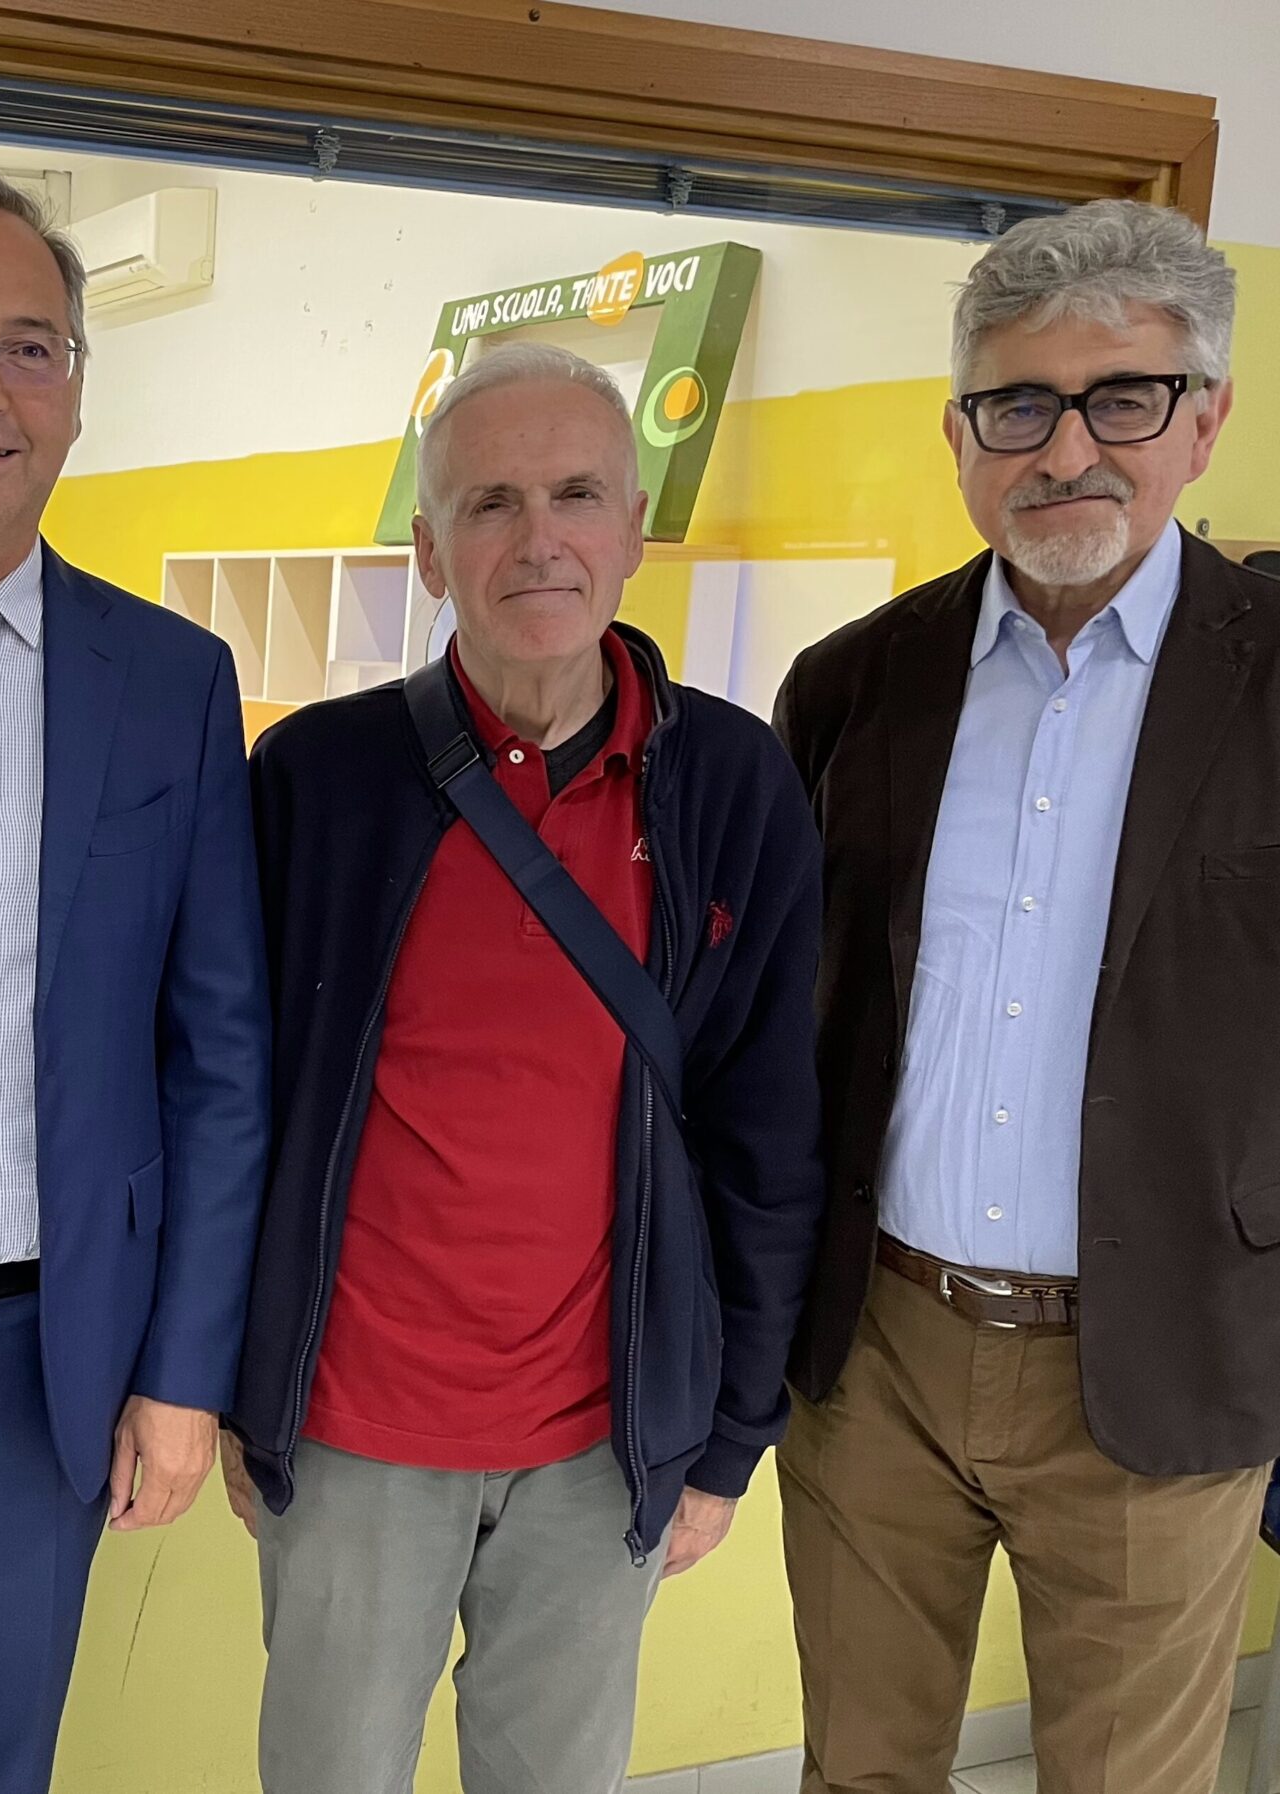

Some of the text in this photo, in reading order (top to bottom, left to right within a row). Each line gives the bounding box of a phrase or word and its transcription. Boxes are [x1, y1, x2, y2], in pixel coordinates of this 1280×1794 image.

[451, 255, 701, 336] UNA SCUOLA, TANTE VOCI
